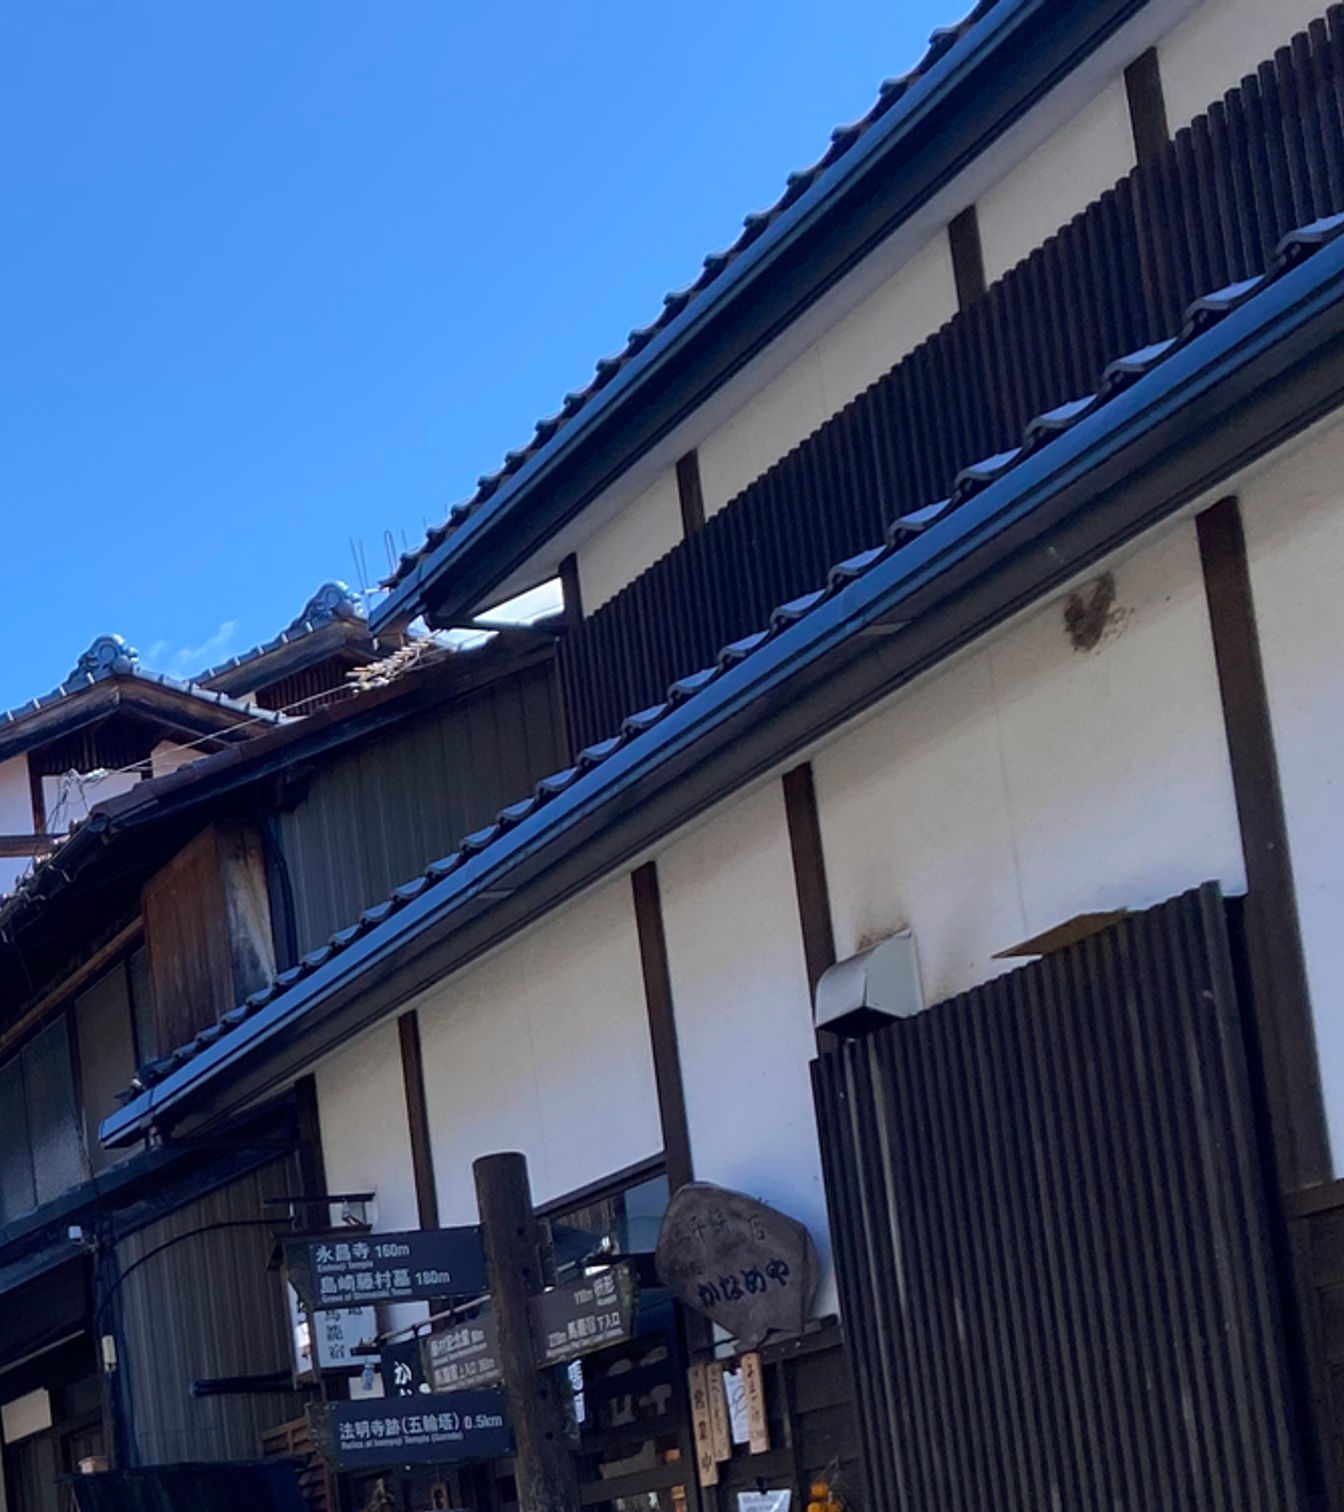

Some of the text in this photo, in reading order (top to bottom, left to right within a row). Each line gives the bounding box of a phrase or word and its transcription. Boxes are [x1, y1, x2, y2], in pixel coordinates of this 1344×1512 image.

[315, 1242, 410, 1263] 永昌寺 160m
[320, 1268, 411, 1294] 島崎藤村墓
[415, 1270, 451, 1285] 180m
[464, 1413, 503, 1429] 0.5km
